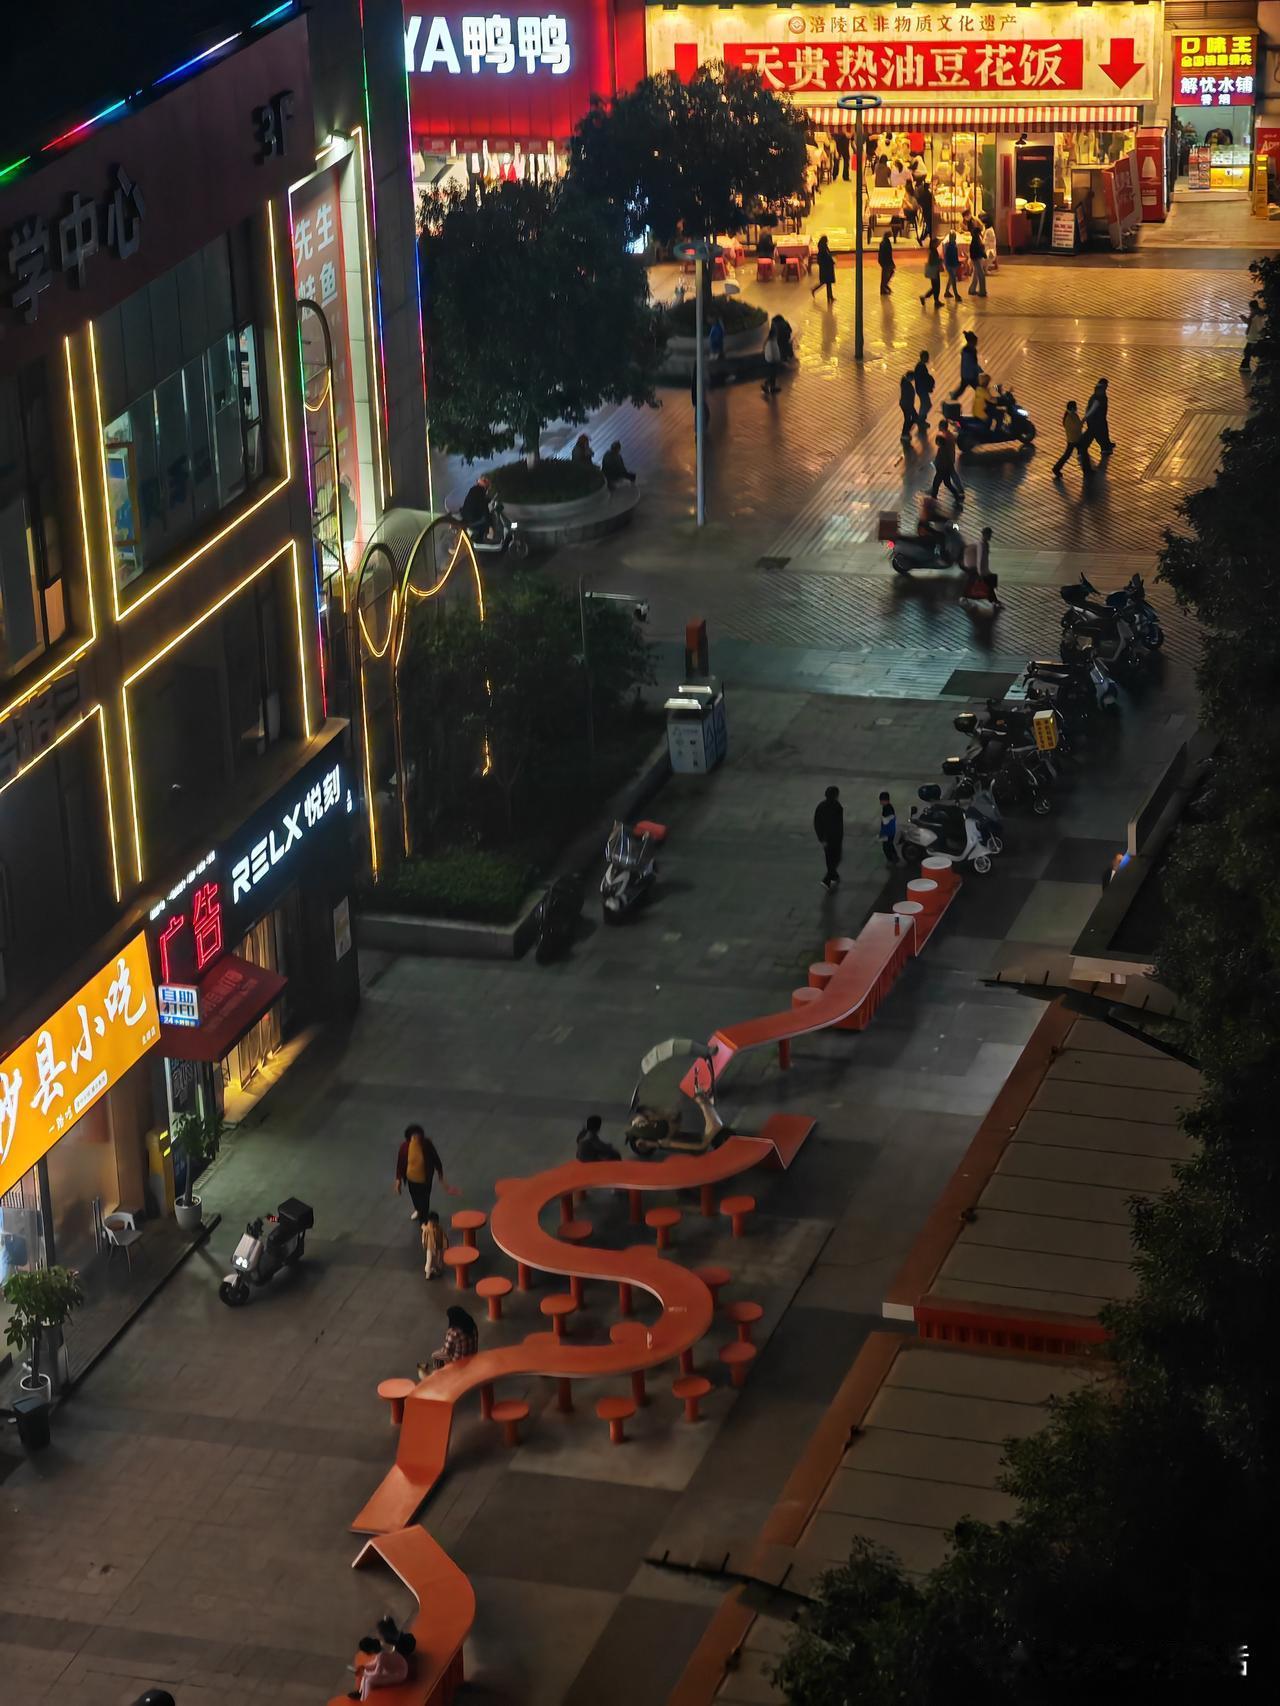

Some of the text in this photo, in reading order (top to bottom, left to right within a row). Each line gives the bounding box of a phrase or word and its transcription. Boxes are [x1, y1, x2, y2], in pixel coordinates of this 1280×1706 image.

[810, 14, 1017, 33] 涪陵区非物质文化遗产
[462, 14, 570, 75] 鸭鸭
[1181, 37, 1252, 54] 口味王
[743, 42, 1066, 90] 天贵热油豆花饭
[1180, 76, 1253, 94] 解忧水铺
[231, 763, 341, 905] RELX 悦刻
[159, 882, 222, 985] 广告
[161, 988, 194, 1003] 自助
